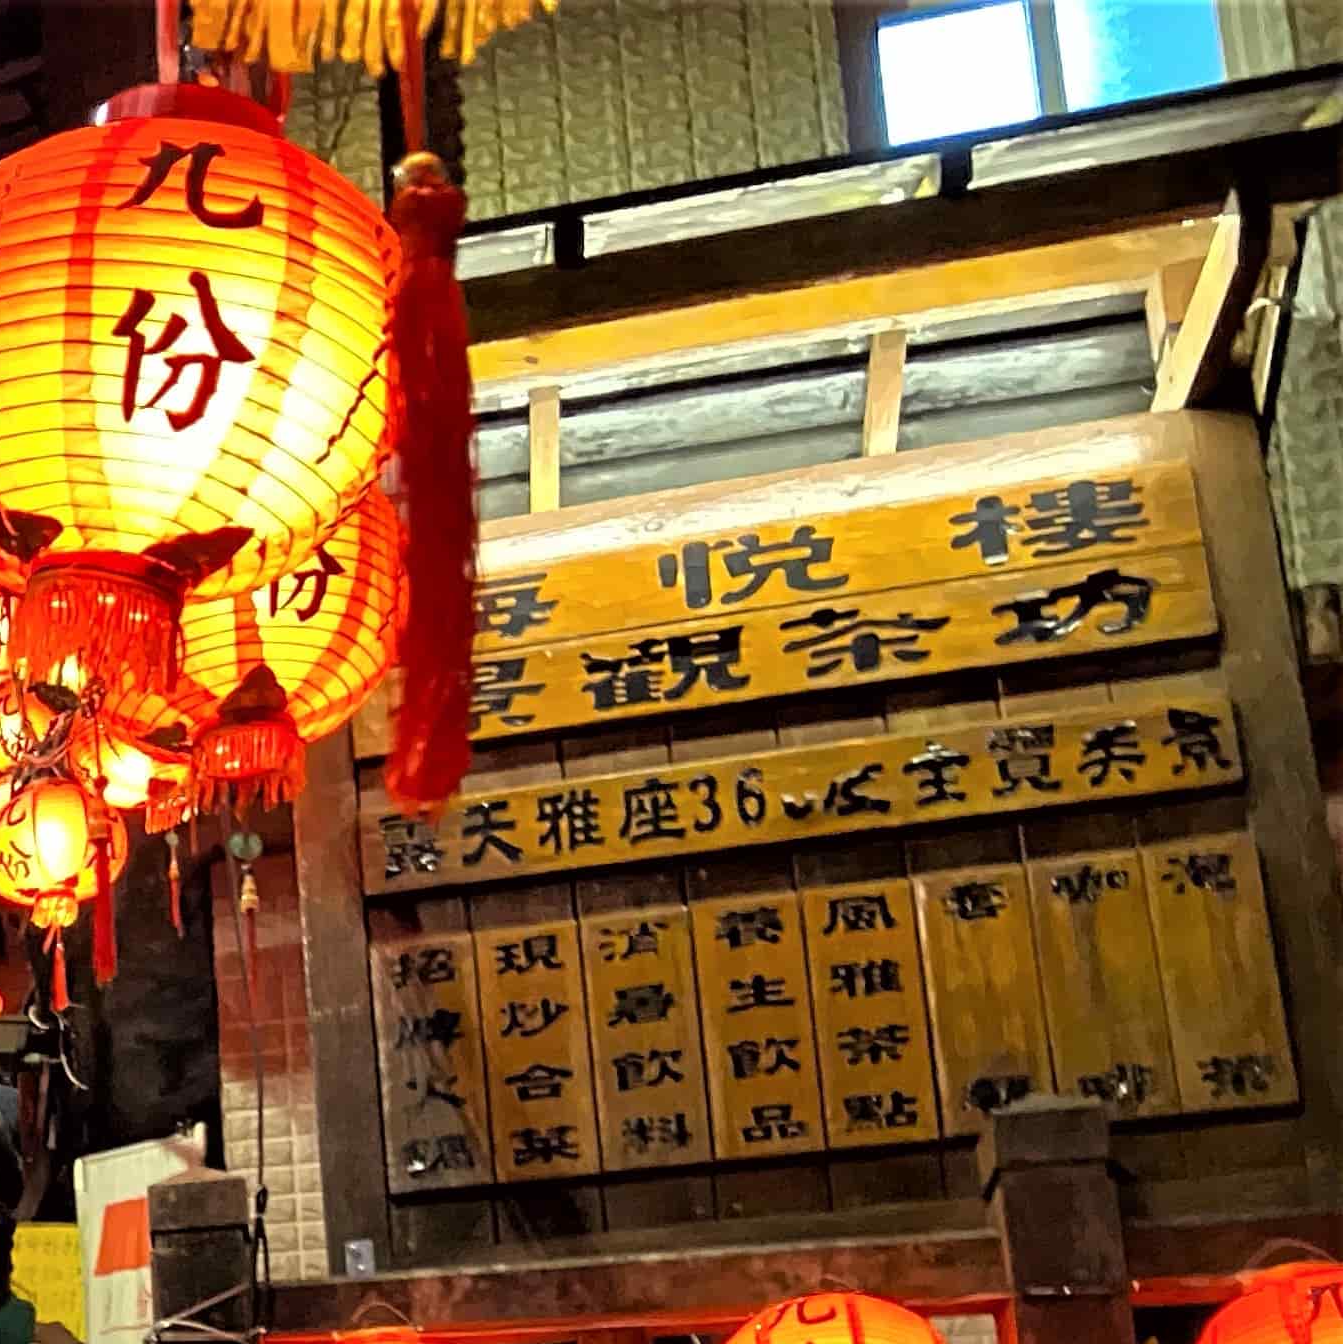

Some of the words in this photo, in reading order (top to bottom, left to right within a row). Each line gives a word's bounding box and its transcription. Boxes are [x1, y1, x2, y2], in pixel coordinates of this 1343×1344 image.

[113, 140, 265, 432] 九份
[0, 797, 33, 880] 九份
[496, 934, 580, 1167] 現炒合菜
[823, 894, 918, 1133] 風雅茶點
